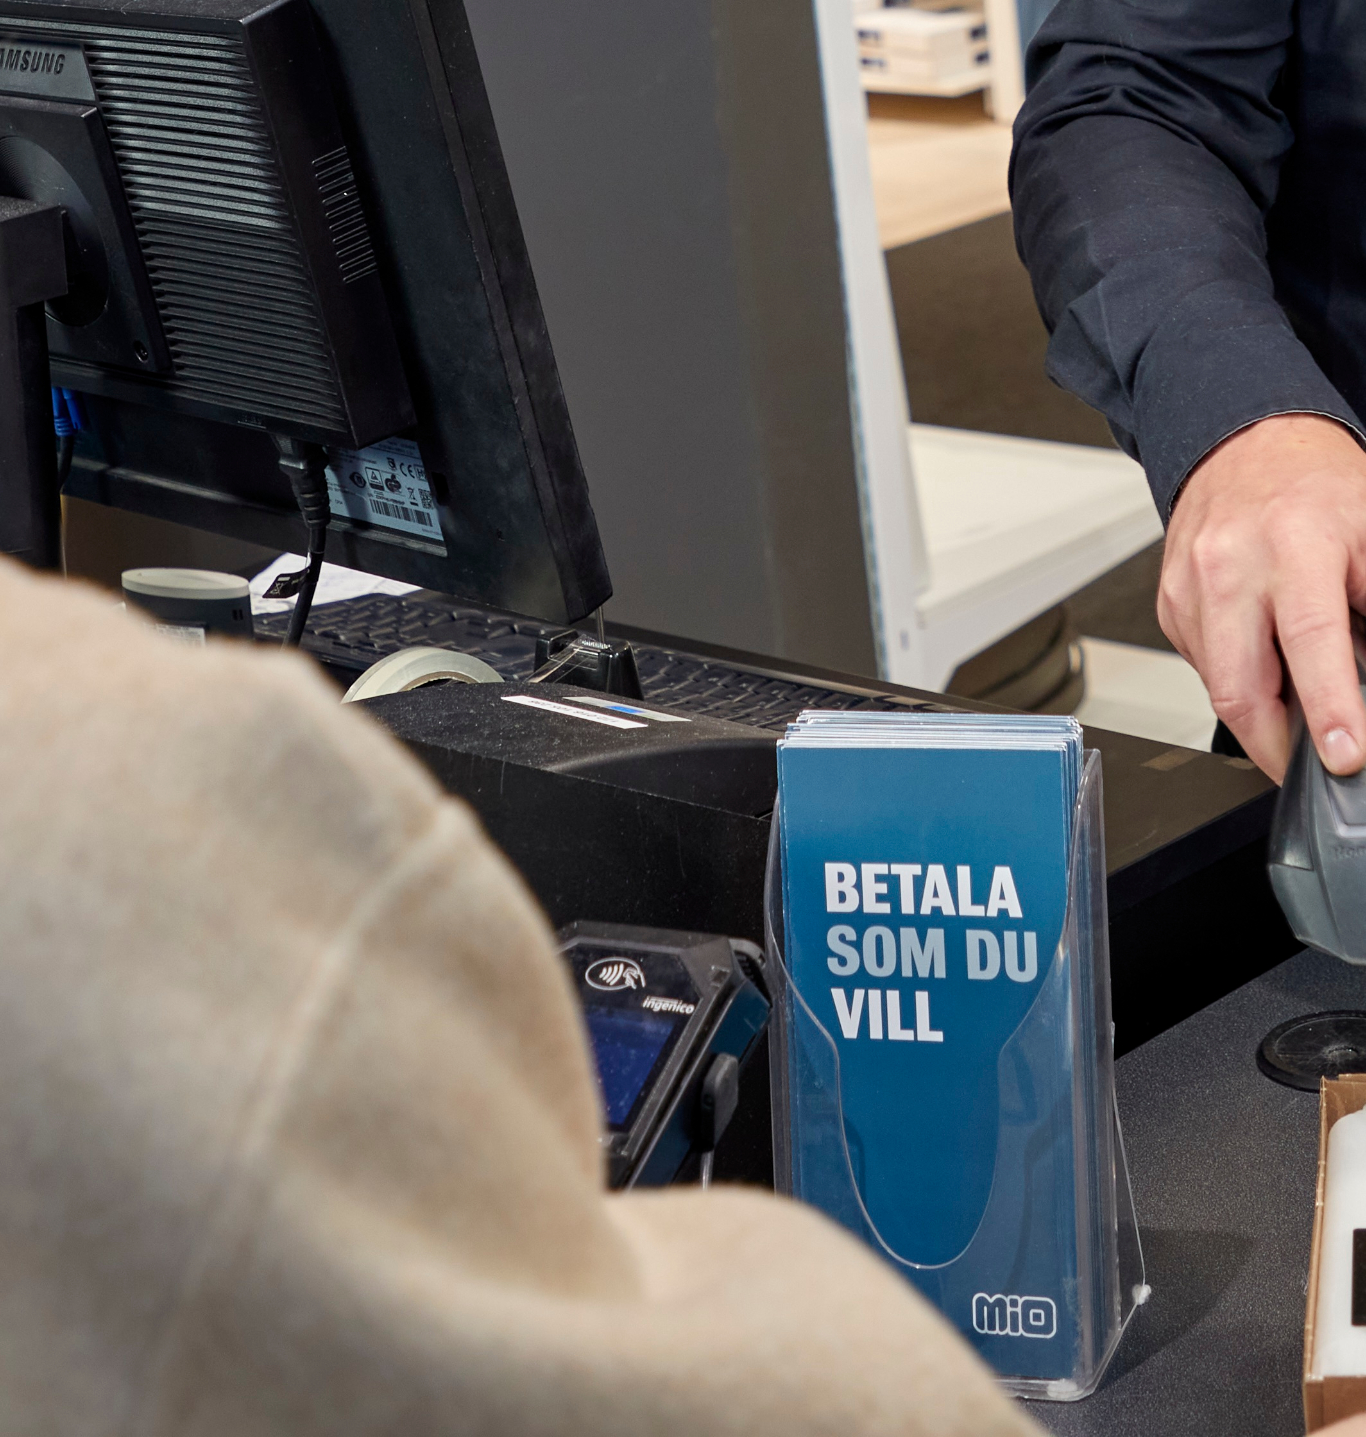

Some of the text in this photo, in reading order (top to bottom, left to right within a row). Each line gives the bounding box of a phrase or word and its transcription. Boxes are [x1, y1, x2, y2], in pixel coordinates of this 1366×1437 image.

[824, 862, 1023, 918] BETALA
[826, 925, 1038, 983] SOM DU
[642, 995, 695, 1014] ingenico
[830, 988, 944, 1042] VILL
